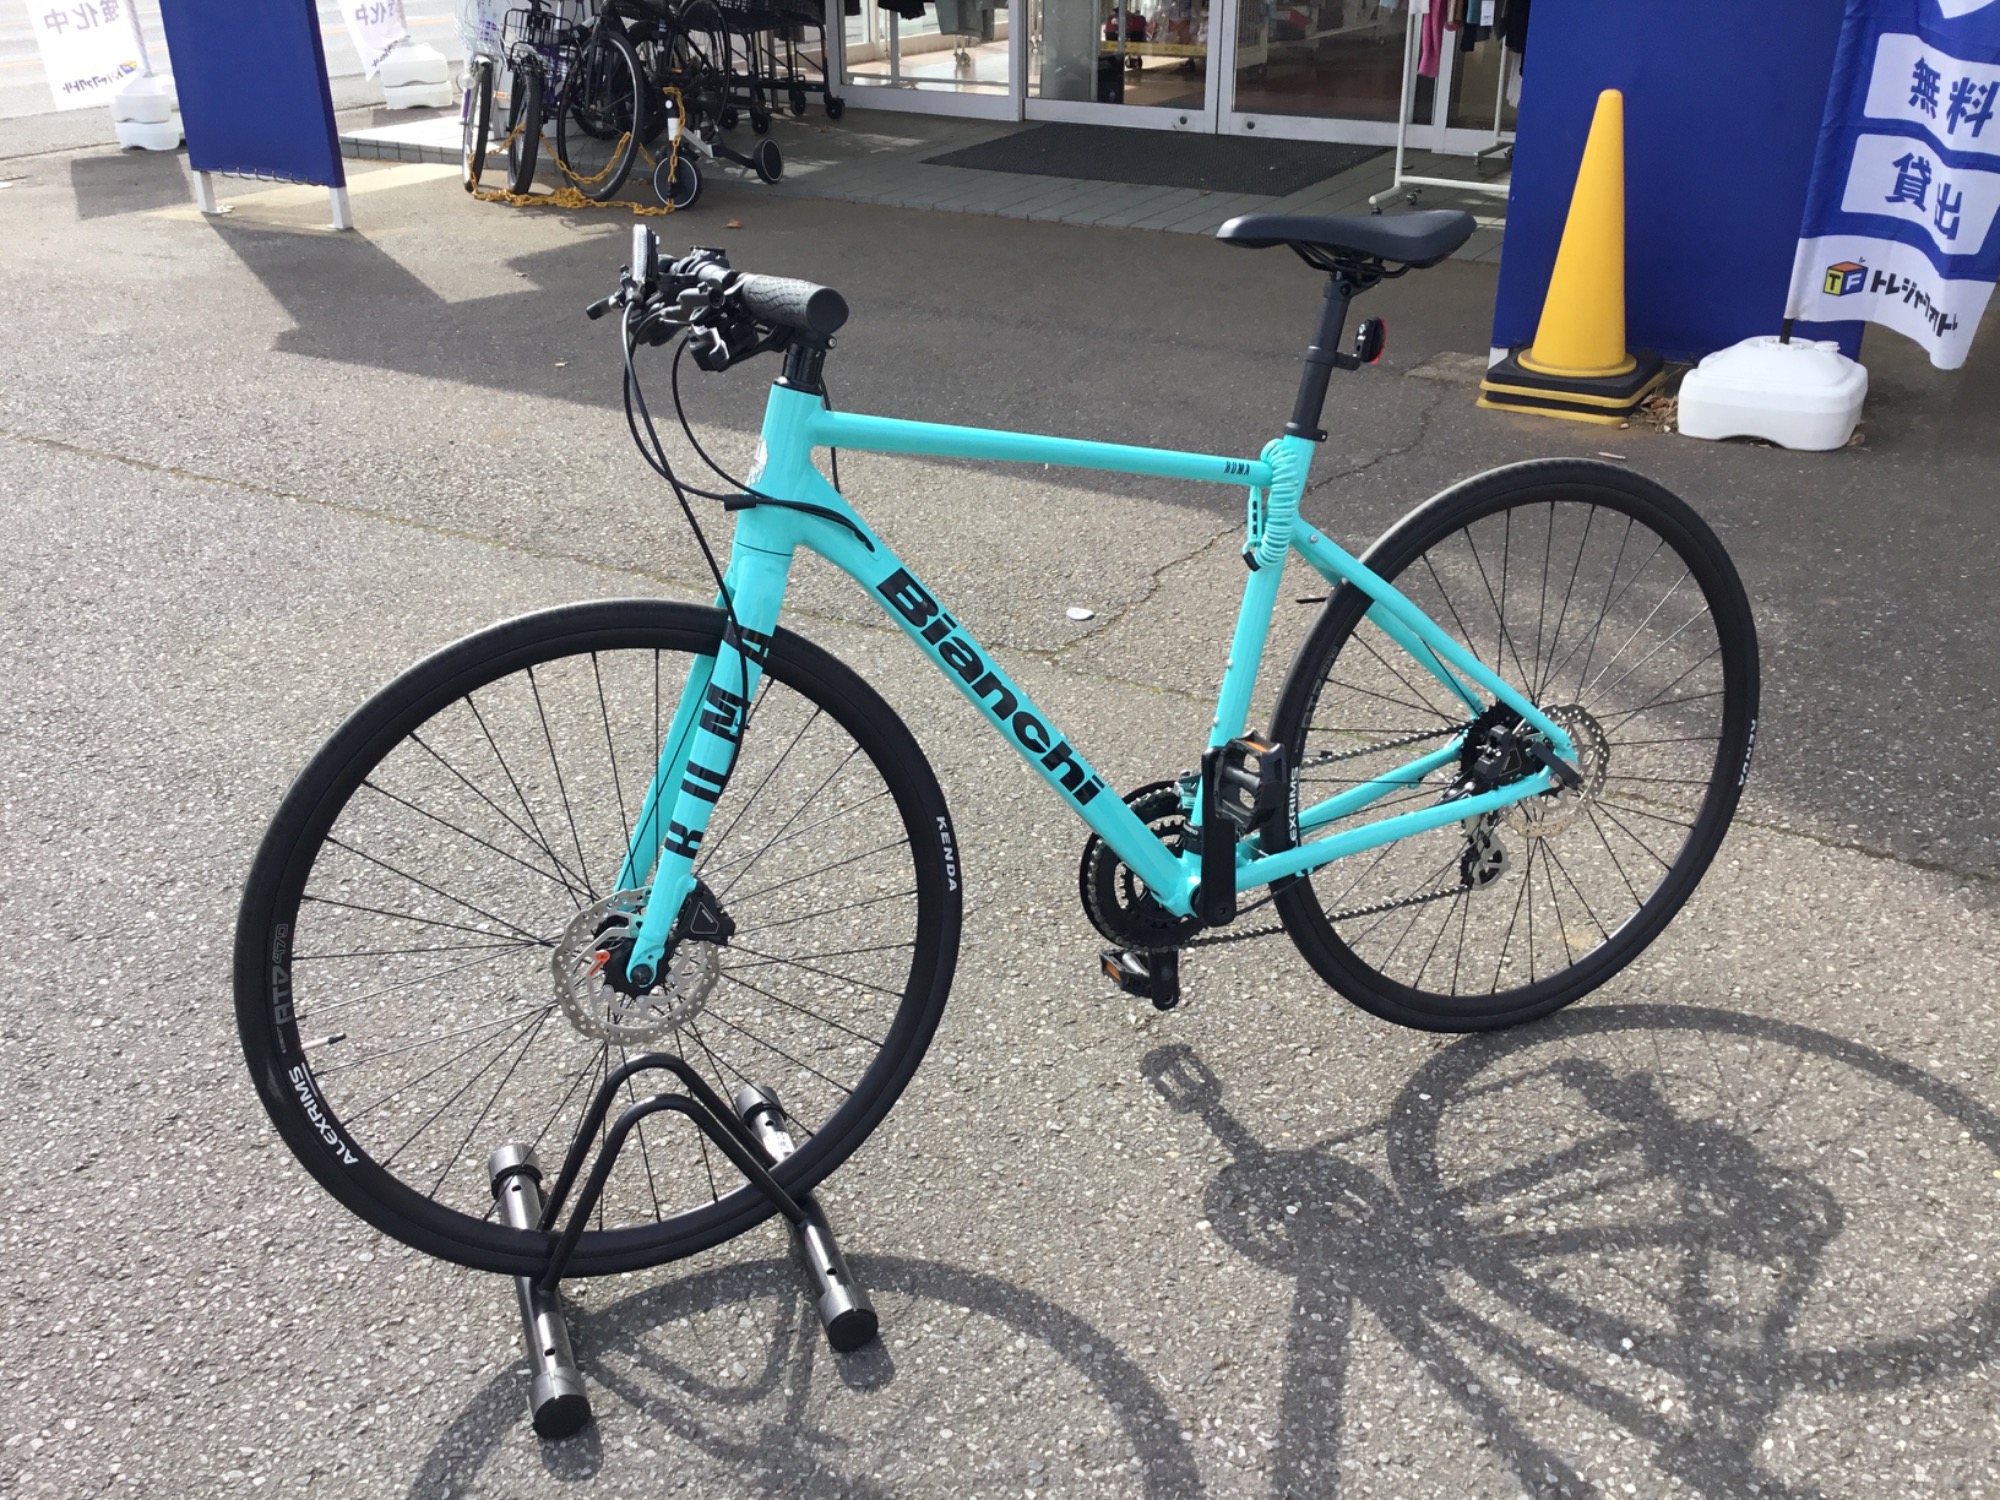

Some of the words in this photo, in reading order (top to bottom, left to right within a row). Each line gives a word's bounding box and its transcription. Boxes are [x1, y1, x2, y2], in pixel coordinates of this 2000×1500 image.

[1908, 56, 2000, 138] 無料
[1884, 152, 1963, 240] 貸出
[876, 567, 1105, 806] Bianchi
[1288, 766, 1299, 848] EXRIMS
[936, 816, 958, 892] KENDA
[288, 1065, 358, 1165] ALEXRIMS
